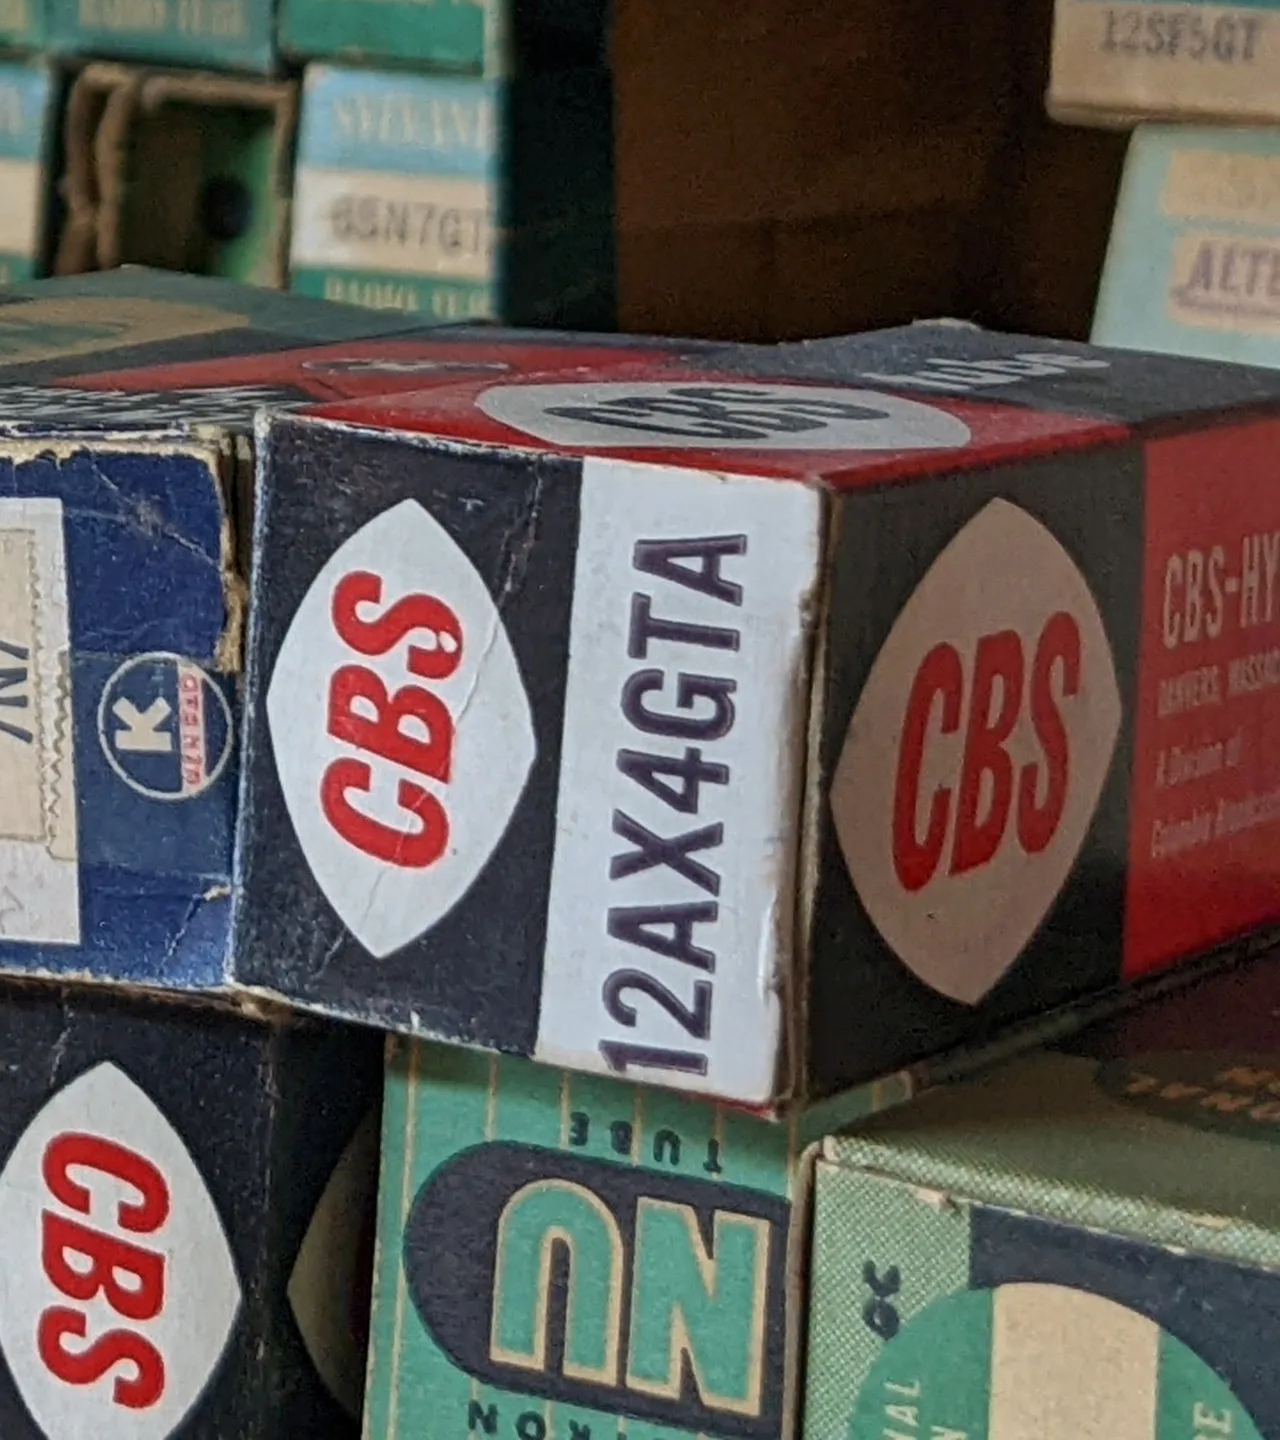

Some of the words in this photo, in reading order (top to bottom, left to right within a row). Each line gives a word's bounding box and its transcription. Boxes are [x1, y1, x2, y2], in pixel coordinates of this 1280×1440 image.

[320, 568, 465, 871] CBS
[598, 533, 749, 1077] 12AX4GTA
[892, 610, 1085, 894] CBS
[39, 1130, 170, 1410] CBS
[567, 1110, 724, 1176] TUBE
[489, 1175, 772, 1418] NU
